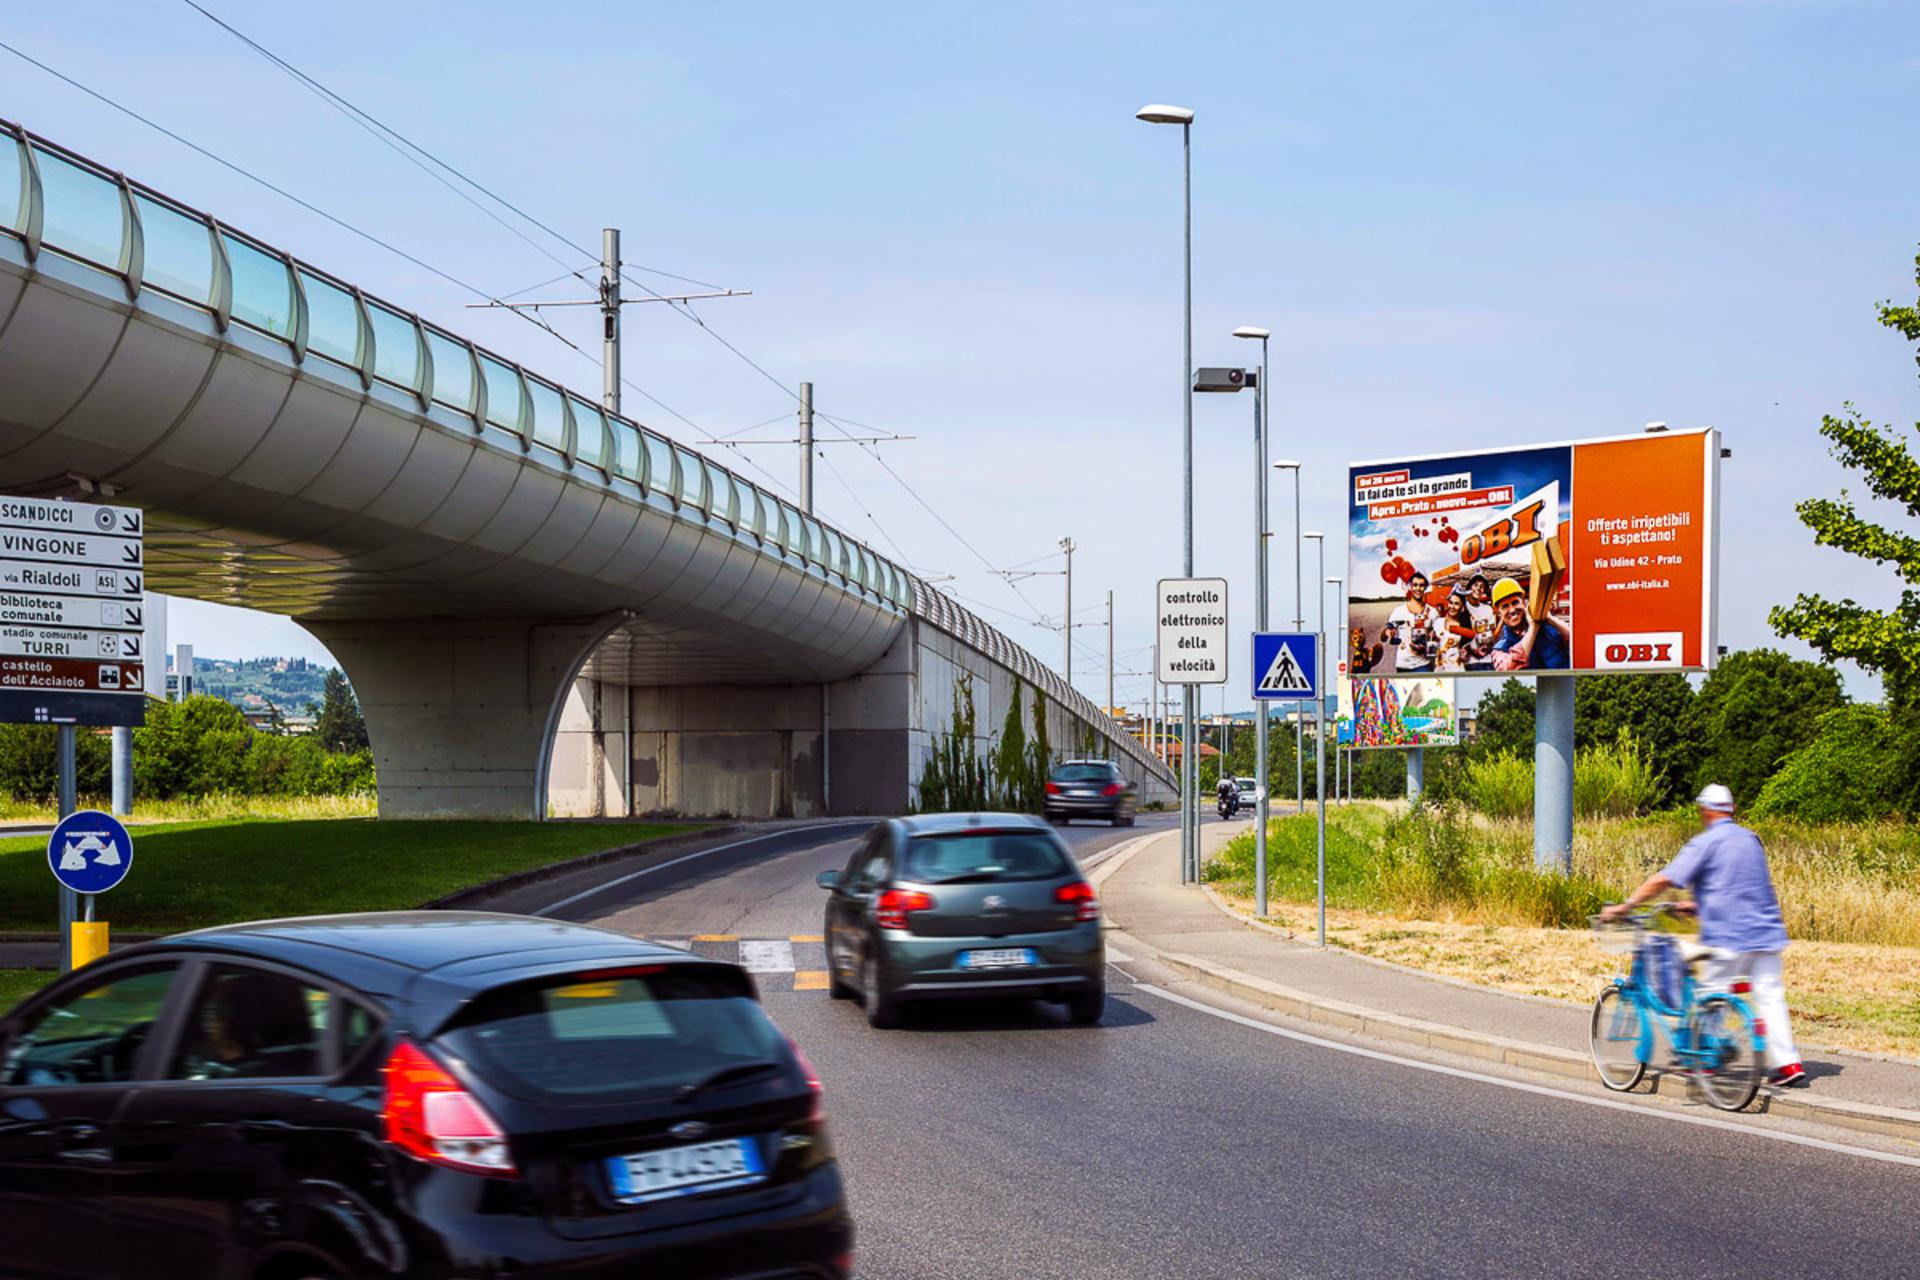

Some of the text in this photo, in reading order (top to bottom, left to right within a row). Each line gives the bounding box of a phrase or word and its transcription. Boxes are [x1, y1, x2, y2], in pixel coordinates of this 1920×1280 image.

[1367, 488, 1381, 500] fai
[1381, 487, 1394, 499] da
[1395, 485, 1406, 497] te
[1407, 484, 1417, 495] si
[1419, 482, 1430, 494] fa
[1431, 478, 1468, 495] grande
[1, 503, 73, 523] SCANDICCI
[1371, 505, 1396, 518] Apre
[1401, 502, 1430, 513] Prato
[1436, 497, 1467, 510] nuovo
[1587, 512, 1690, 532] Offerte irripetibili
[1461, 499, 1544, 565] OBI
[1601, 529, 1676, 546] ti aspettano!
[3, 535, 87, 556] VINGONE
[1594, 558, 1609, 568] Via
[1610, 556, 1635, 568] Udine
[1636, 556, 1649, 566] 42
[1657, 554, 1682, 565] Prato
[4, 569, 81, 587] via Rialdoli
[98, 576, 116, 588] ASL
[1605, 579, 1670, 591] www.obi-italia.it
[0, 595, 63, 610] biblioteca
[1166, 590, 1219, 604] controllo
[1, 609, 63, 623] comunale
[1161, 613, 1225, 627] elettronico
[2, 628, 88, 641] stadio comunale
[22, 641, 70, 655] TURRI
[1177, 636, 1208, 649] della
[1604, 643, 1673, 663] OBI
[2, 661, 52, 673] castello
[1169, 658, 1216, 672] velocità
